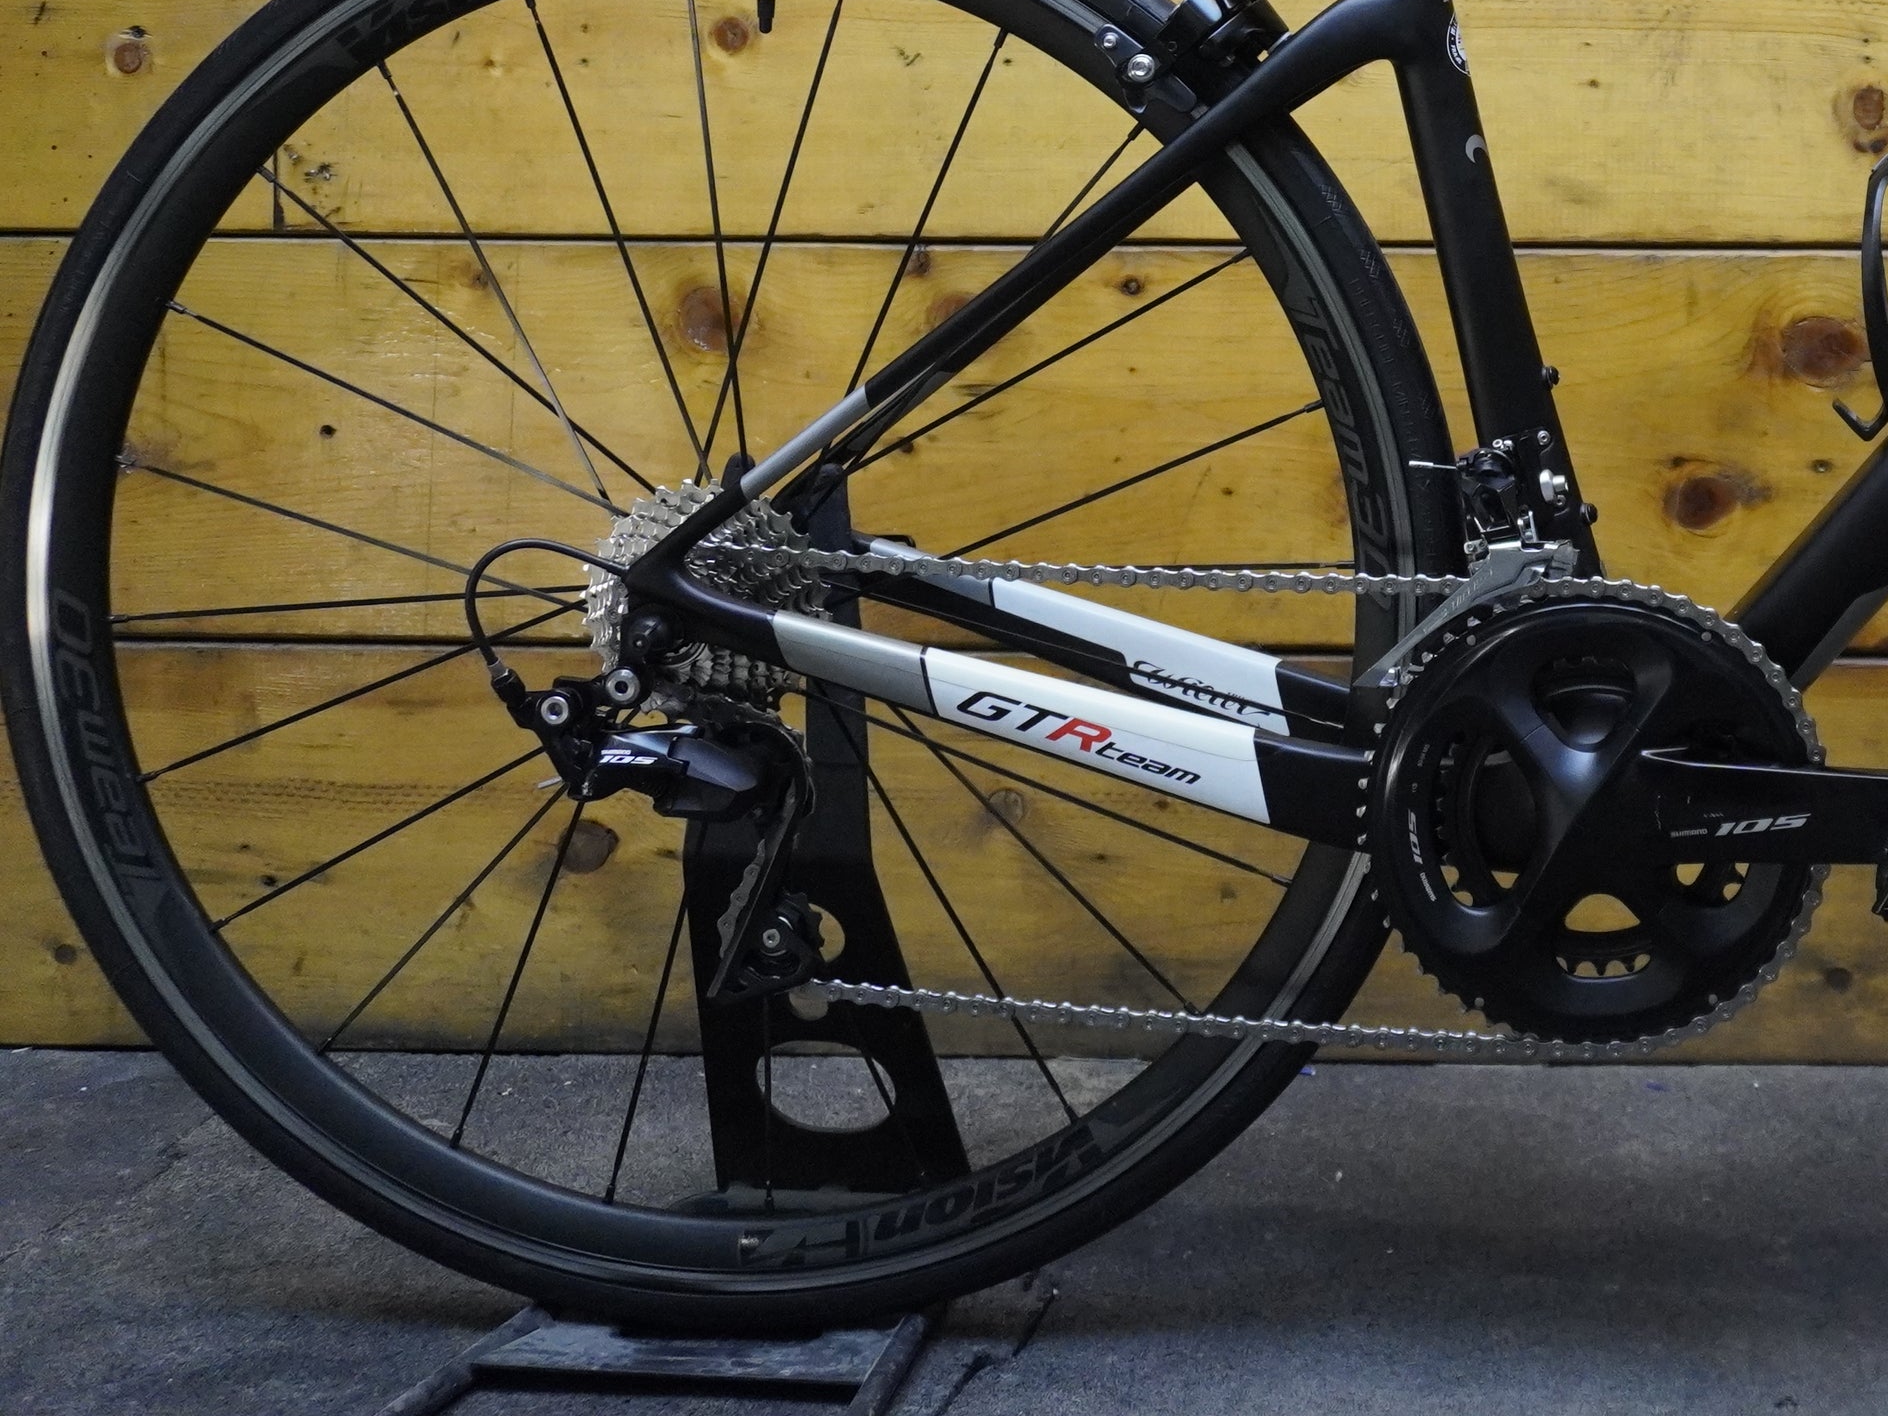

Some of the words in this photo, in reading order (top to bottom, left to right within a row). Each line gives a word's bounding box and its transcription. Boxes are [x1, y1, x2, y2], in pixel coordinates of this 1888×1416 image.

[600, 755, 658, 765] 105
[1408, 808, 1424, 865] 105
[1714, 813, 1811, 837] 105
